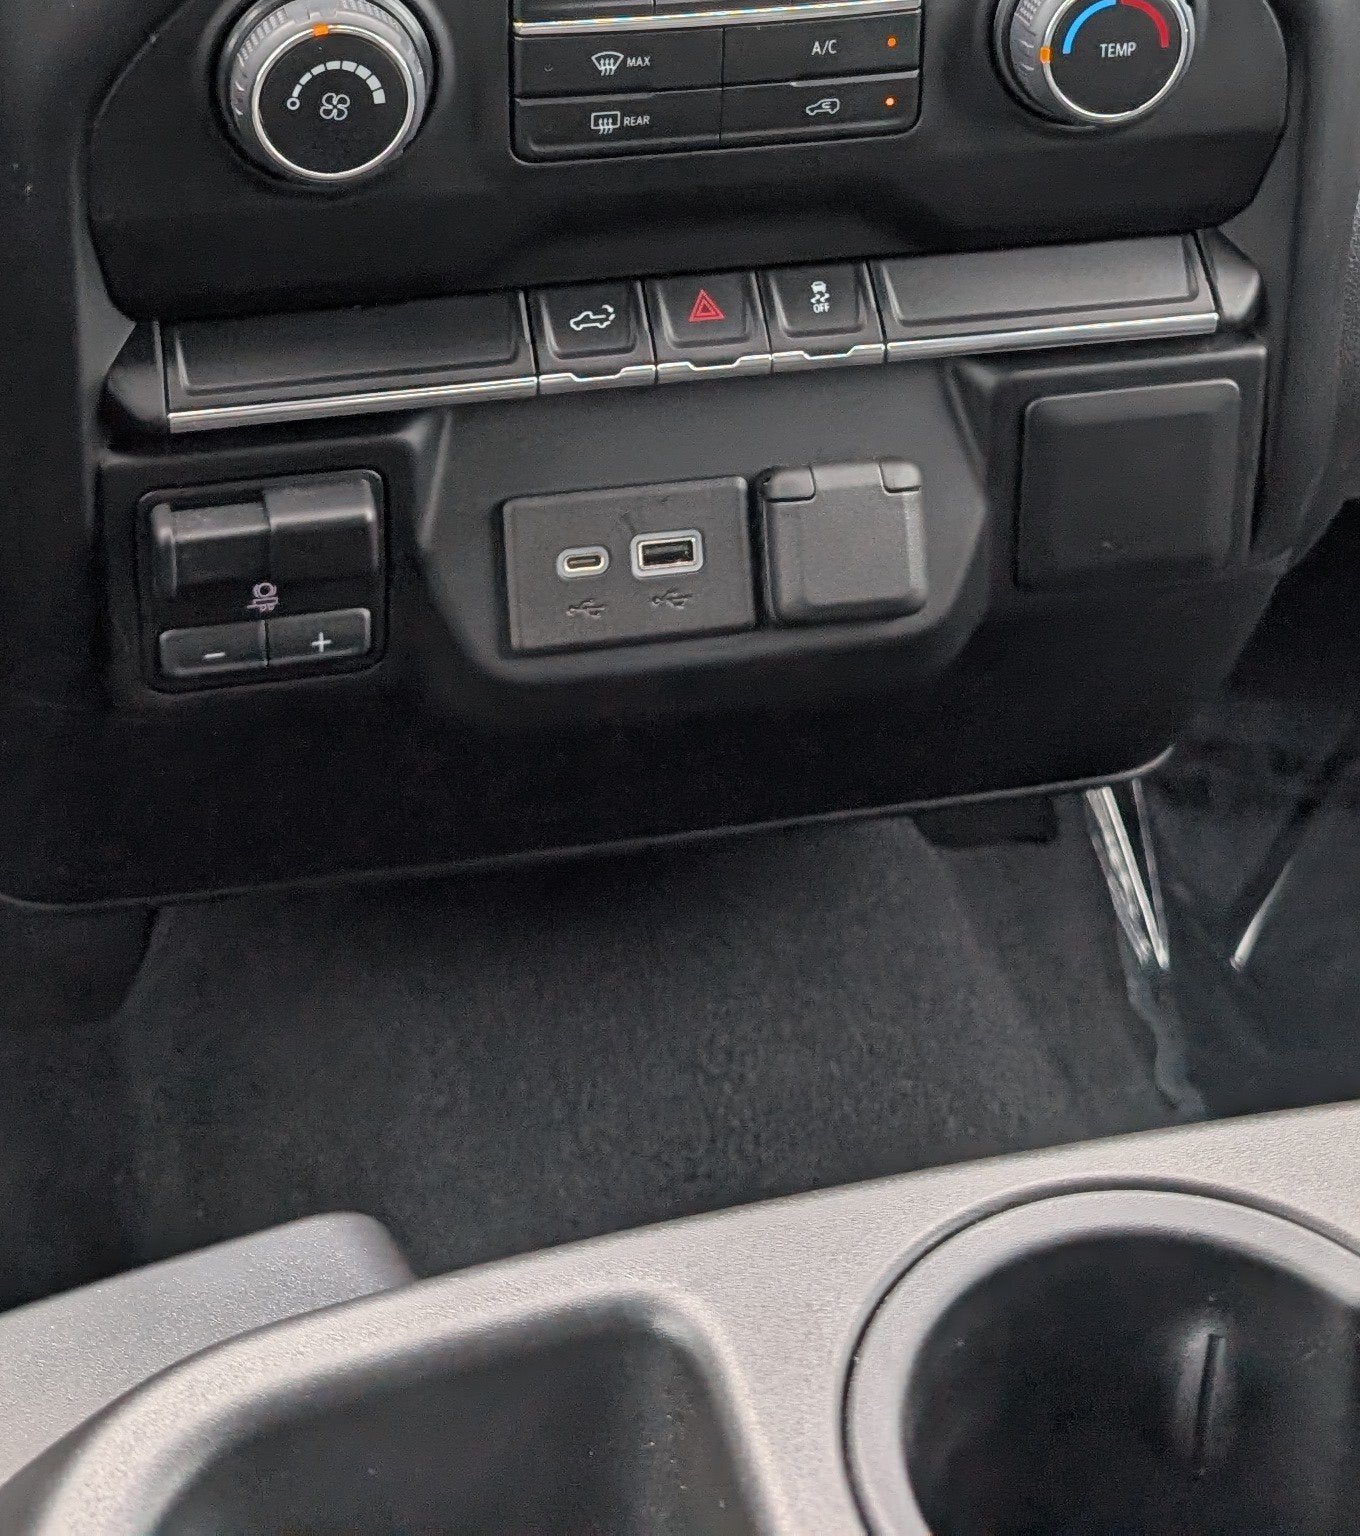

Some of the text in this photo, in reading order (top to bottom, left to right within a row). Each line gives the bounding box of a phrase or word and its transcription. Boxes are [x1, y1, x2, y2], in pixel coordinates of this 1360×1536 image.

[811, 39, 838, 56] A/C
[1099, 41, 1138, 58] TEMP
[625, 56, 651, 68] MAX
[623, 114, 651, 127] REAR
[812, 302, 830, 314] OFF
